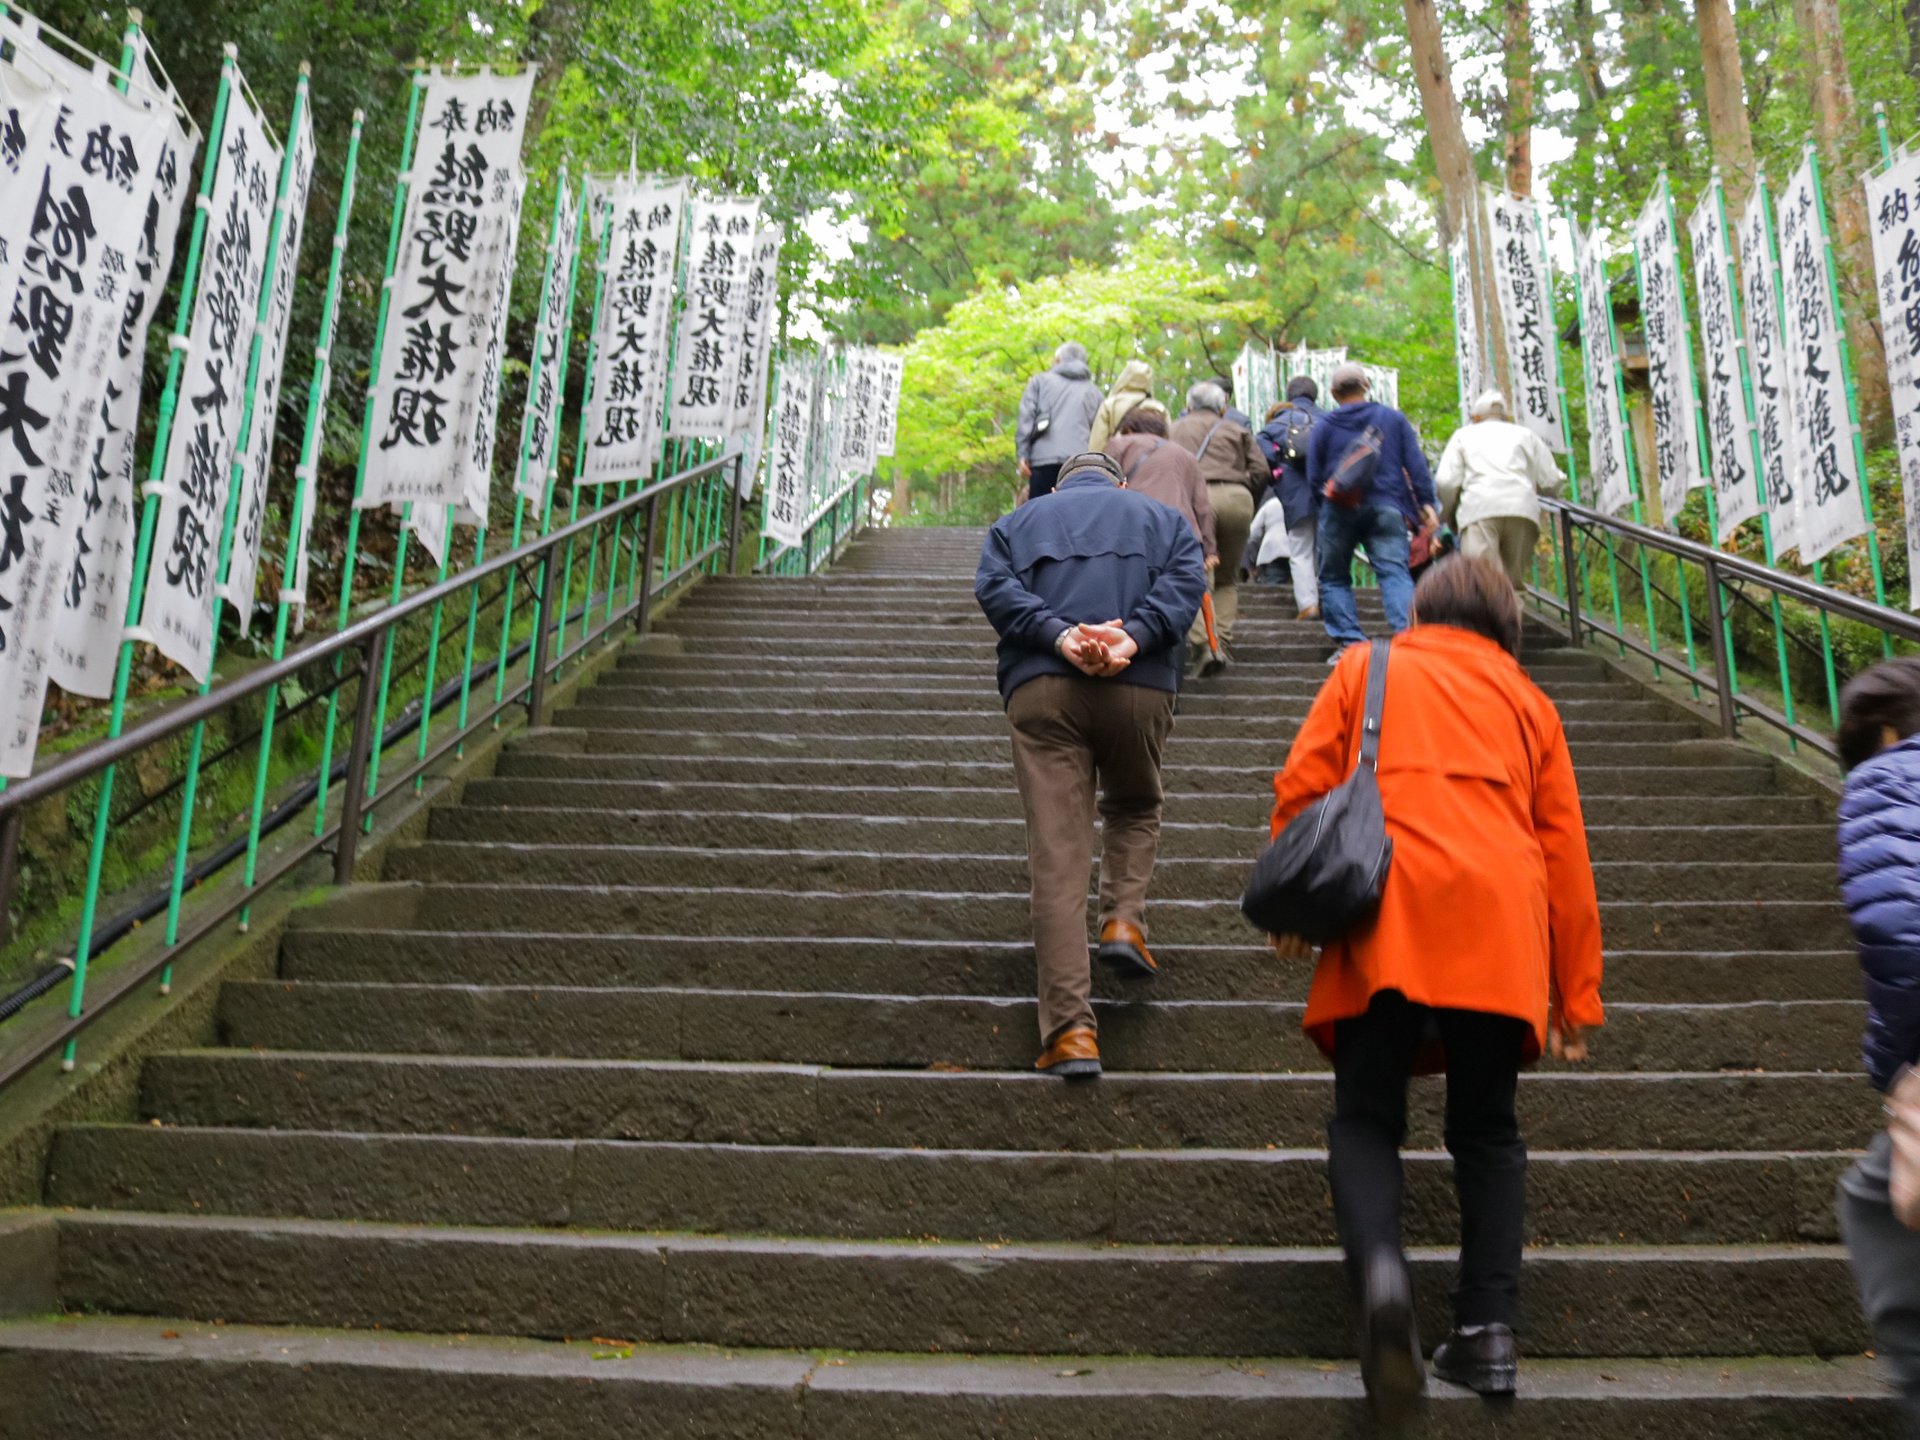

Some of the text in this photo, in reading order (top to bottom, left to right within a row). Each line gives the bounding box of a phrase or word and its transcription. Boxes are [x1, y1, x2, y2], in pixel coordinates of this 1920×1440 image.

[1507, 237, 1556, 424] 熊野大権現
[1794, 229, 1850, 507] 熊野大権現
